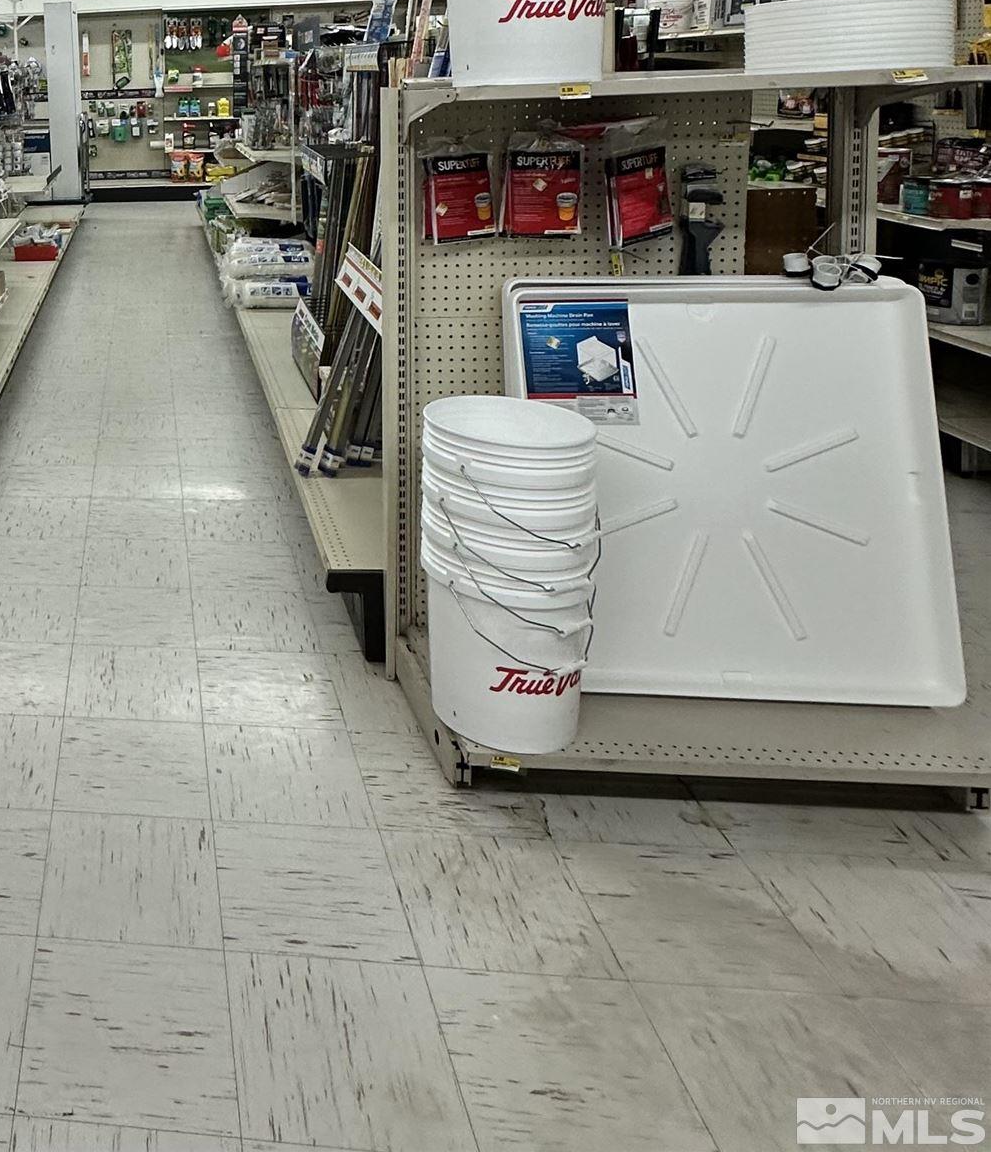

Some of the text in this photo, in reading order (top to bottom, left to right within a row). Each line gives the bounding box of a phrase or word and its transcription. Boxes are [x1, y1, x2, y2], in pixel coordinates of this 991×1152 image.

[438, 158, 480, 171] SUPERTUFF
[516, 155, 572, 169] SUPERTUFF
[621, 153, 658, 171] SUPERTUFF
[489, 666, 555, 696] True
